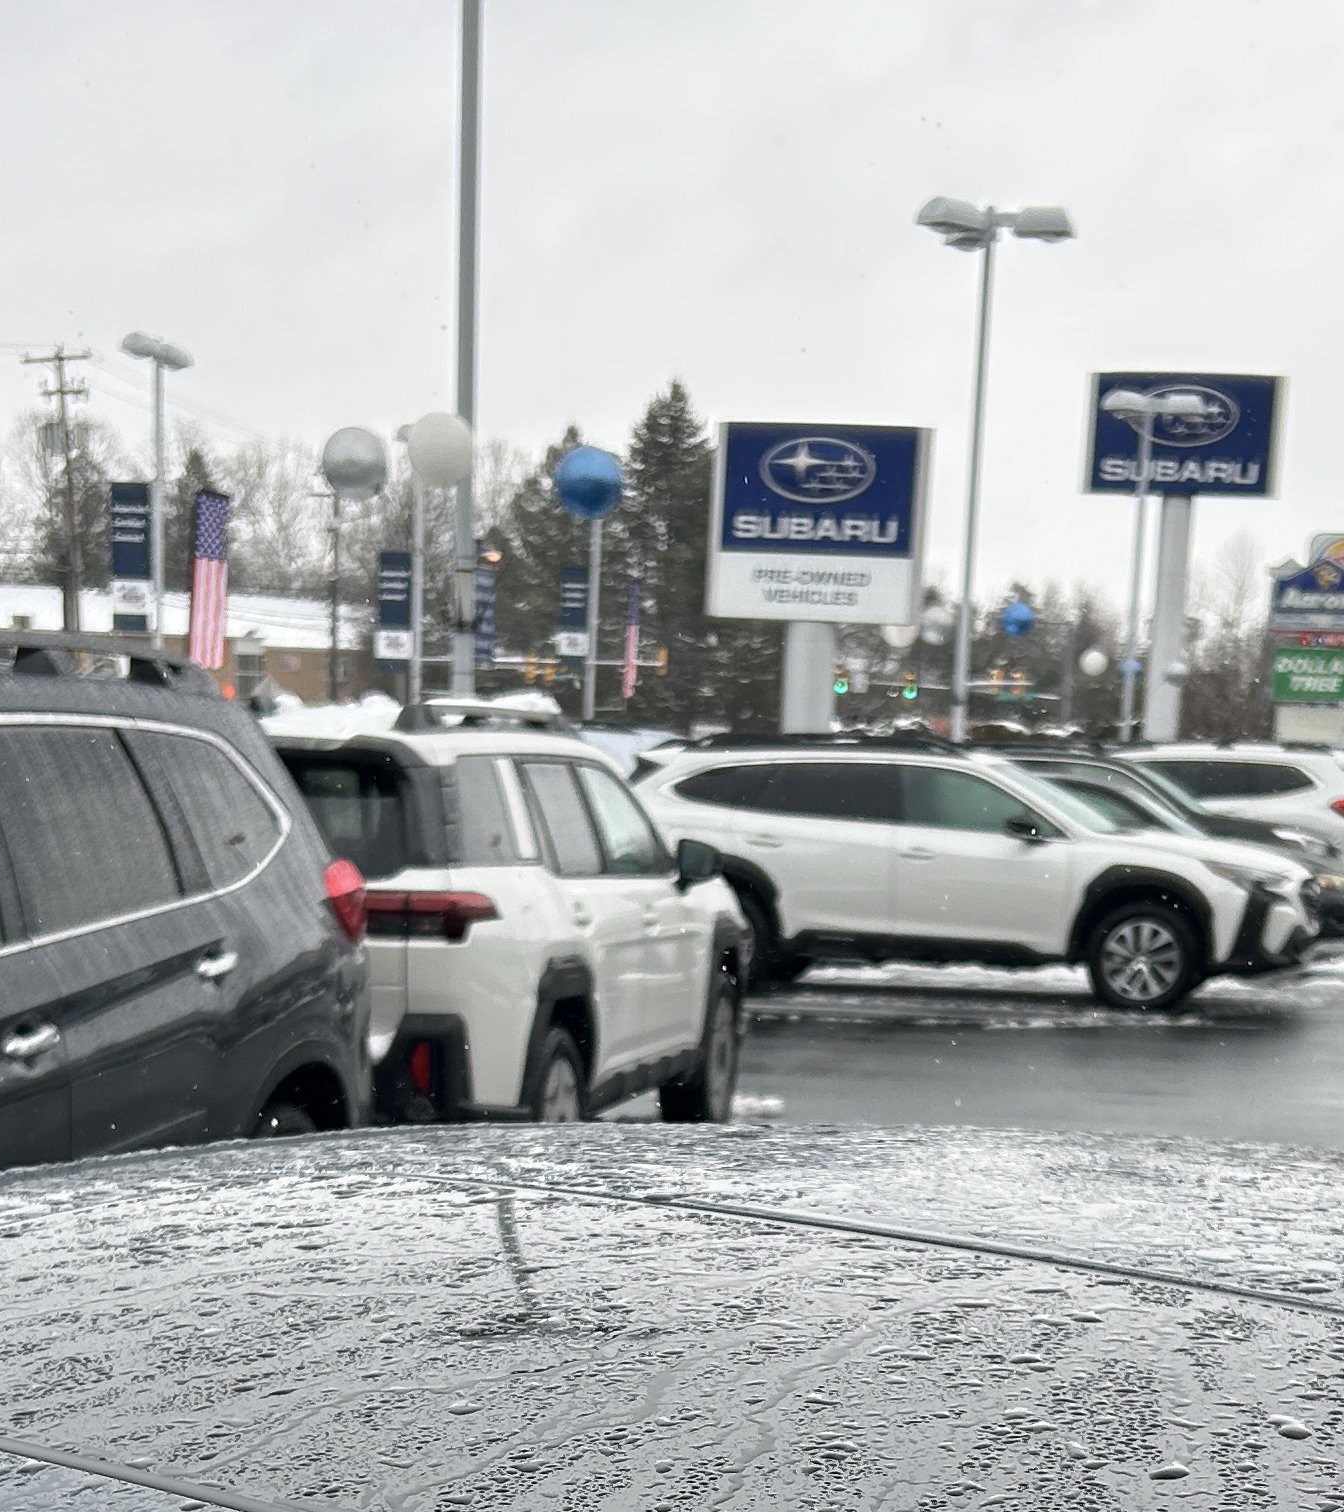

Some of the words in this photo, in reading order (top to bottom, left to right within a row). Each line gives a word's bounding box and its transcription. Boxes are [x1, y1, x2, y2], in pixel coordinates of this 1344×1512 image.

[1099, 456, 1261, 485] SUBARU
[732, 511, 899, 544] SUBARU
[751, 567, 873, 588] PRE-OWNED
[762, 588, 858, 606] VEHICLES
